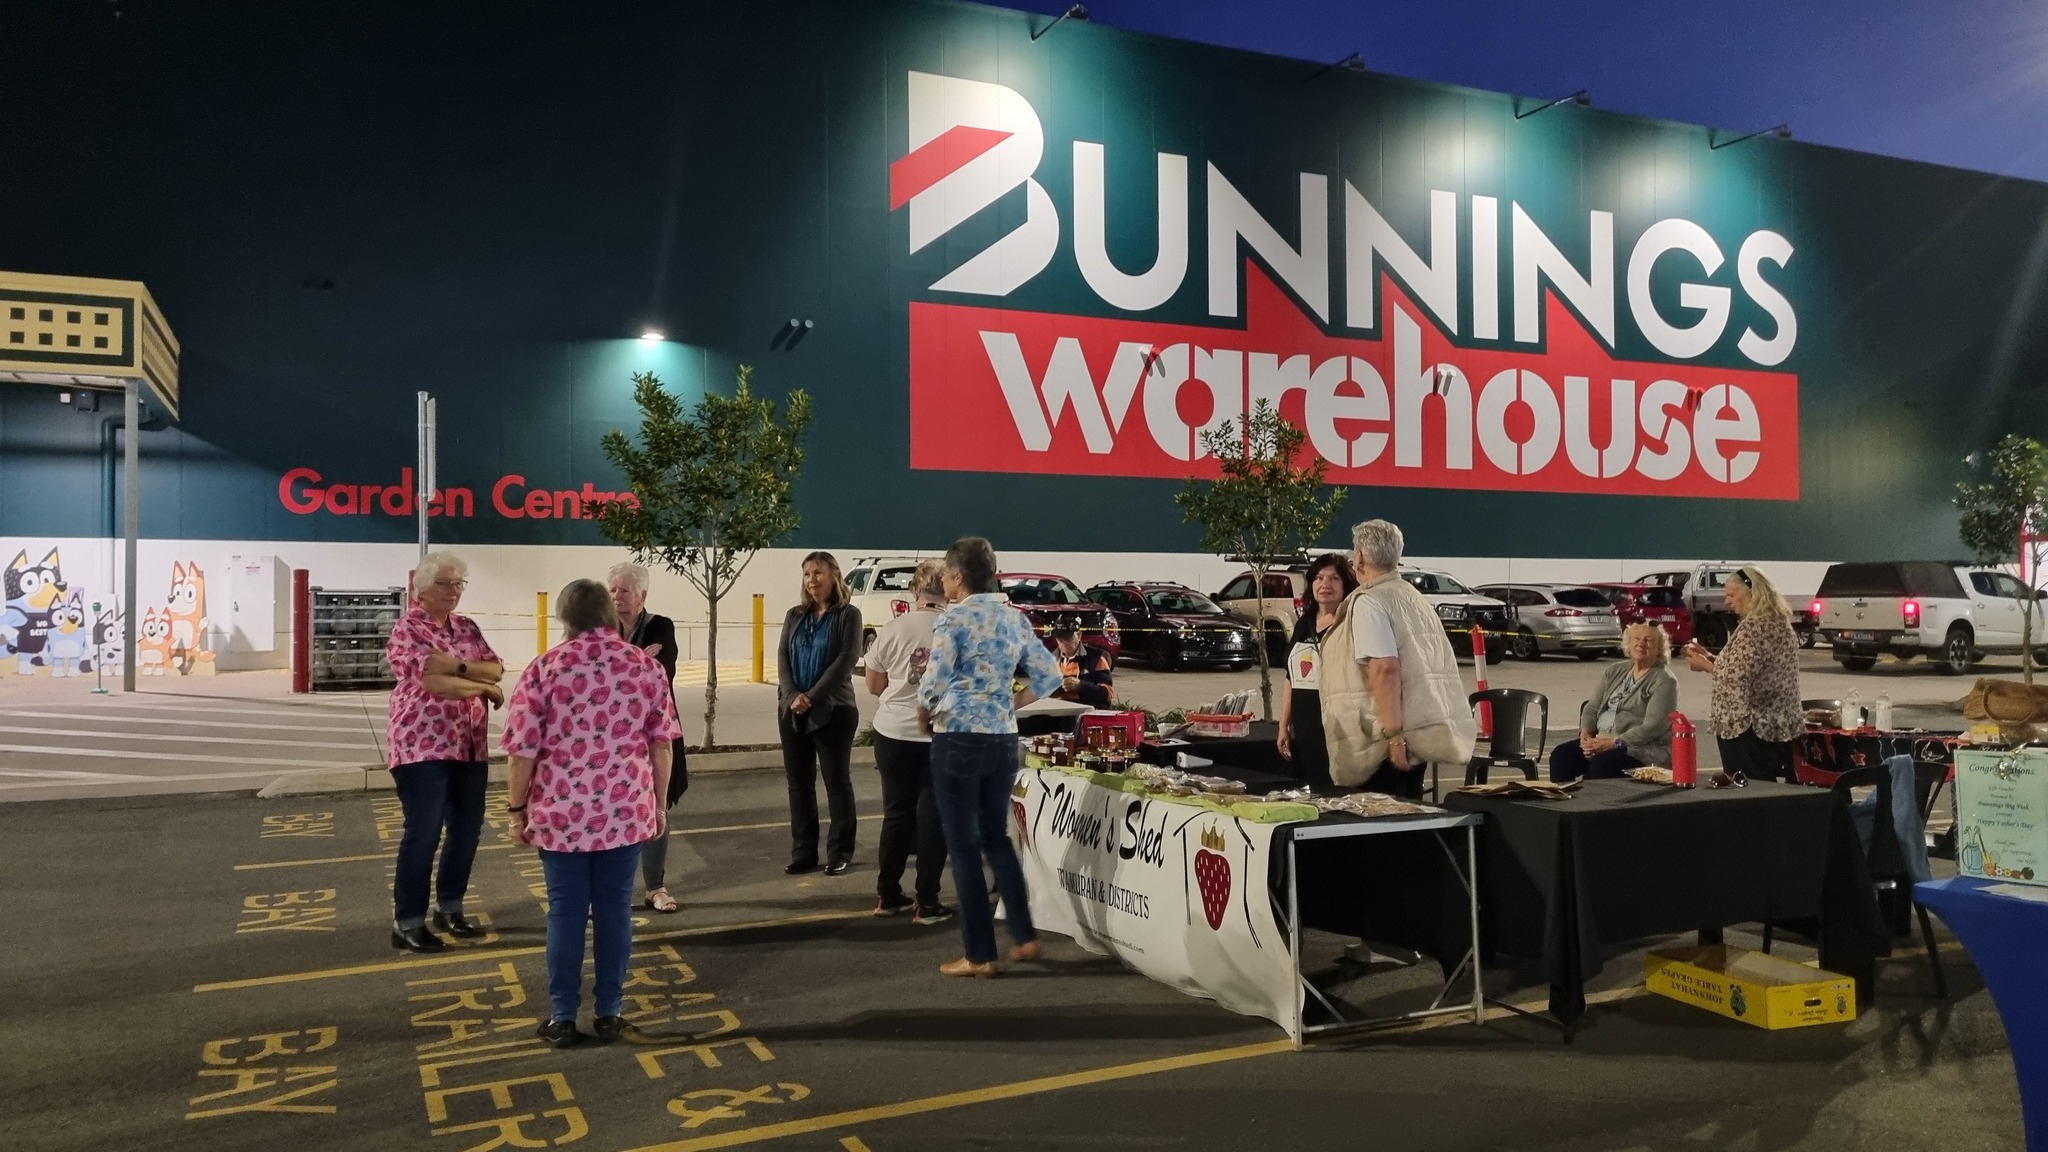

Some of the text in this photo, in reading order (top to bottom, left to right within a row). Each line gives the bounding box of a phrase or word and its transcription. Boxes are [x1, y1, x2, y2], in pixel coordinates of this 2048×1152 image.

[890, 70, 1798, 366] BUNNINGS
[979, 305, 1761, 484] warehouse
[278, 467, 474, 518] Garden
[259, 811, 337, 839] BAY
[1051, 782, 1168, 869] Women's Shed
[234, 887, 337, 935] BAY
[1098, 880, 1105, 903] &
[1108, 883, 1150, 920] DISTRICTS
[184, 1025, 338, 1121] BAY
[404, 961, 590, 1152] TRAILER
